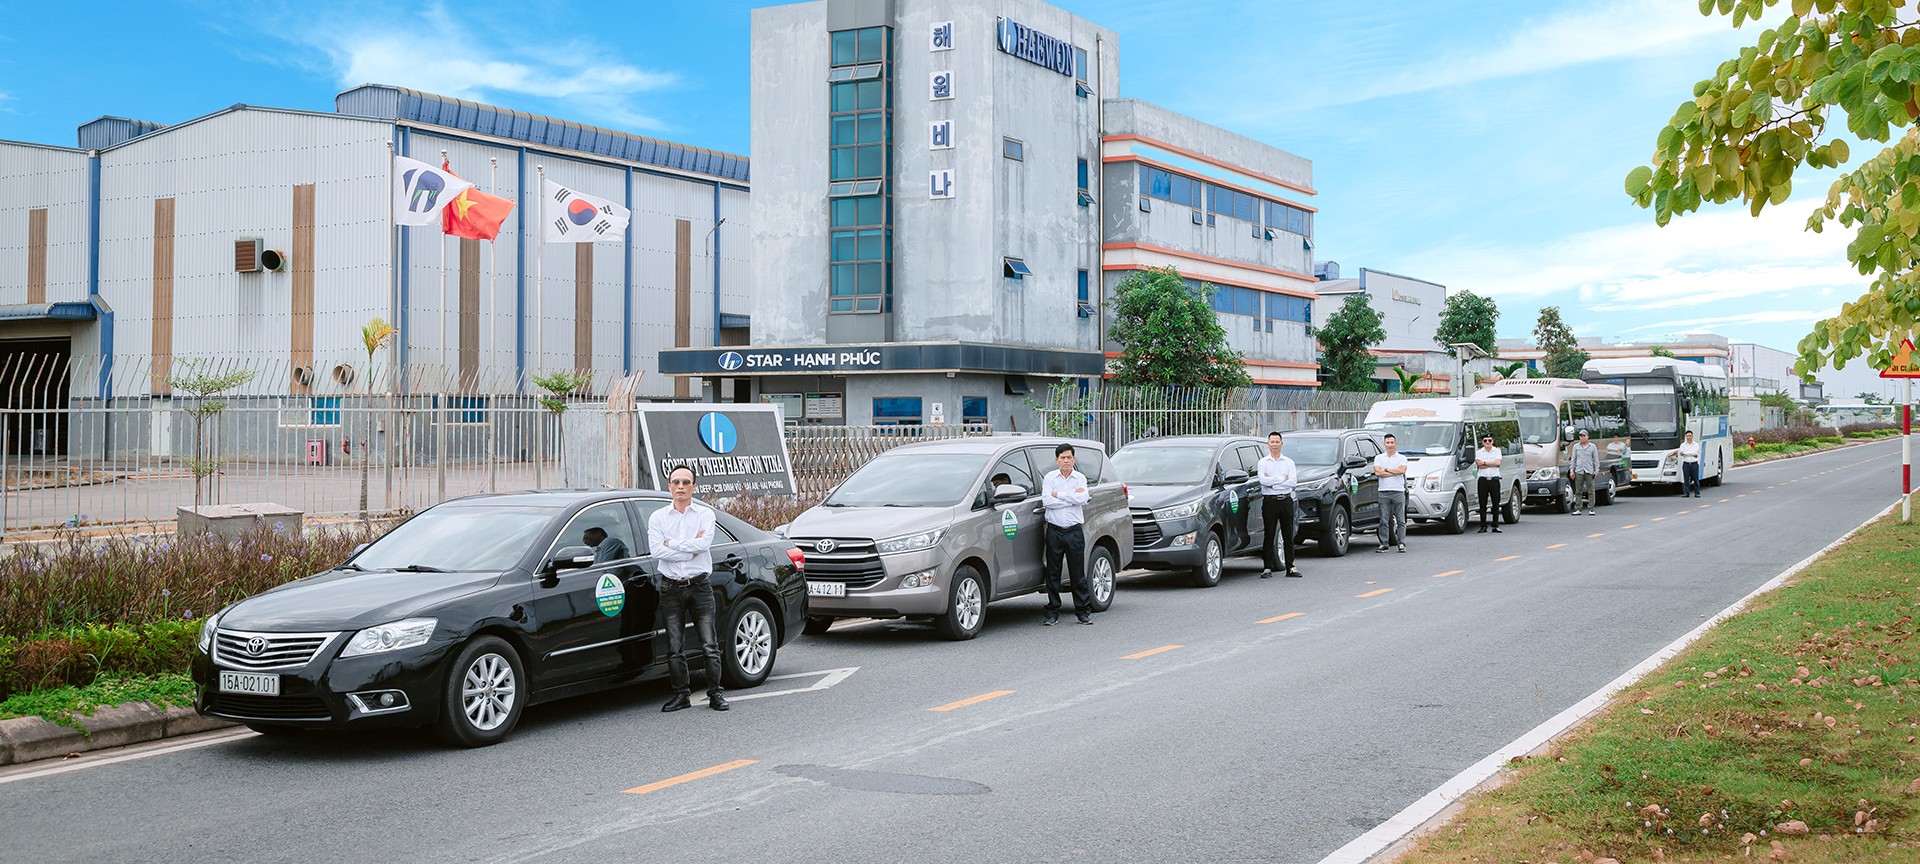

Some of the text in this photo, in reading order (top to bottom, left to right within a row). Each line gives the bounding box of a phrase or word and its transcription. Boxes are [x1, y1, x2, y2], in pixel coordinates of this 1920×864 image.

[1014, 22, 1074, 77] HAEWON
[746, 354, 783, 367] STAR
[794, 353, 836, 368] HẠNH
[840, 349, 881, 366] PHÚC
[661, 452, 686, 479] CÔ
[699, 457, 727, 476] TNHH
[725, 455, 762, 475] HAEWON
[761, 455, 784, 473] VINA
[222, 674, 275, 693] 15A-021.01
